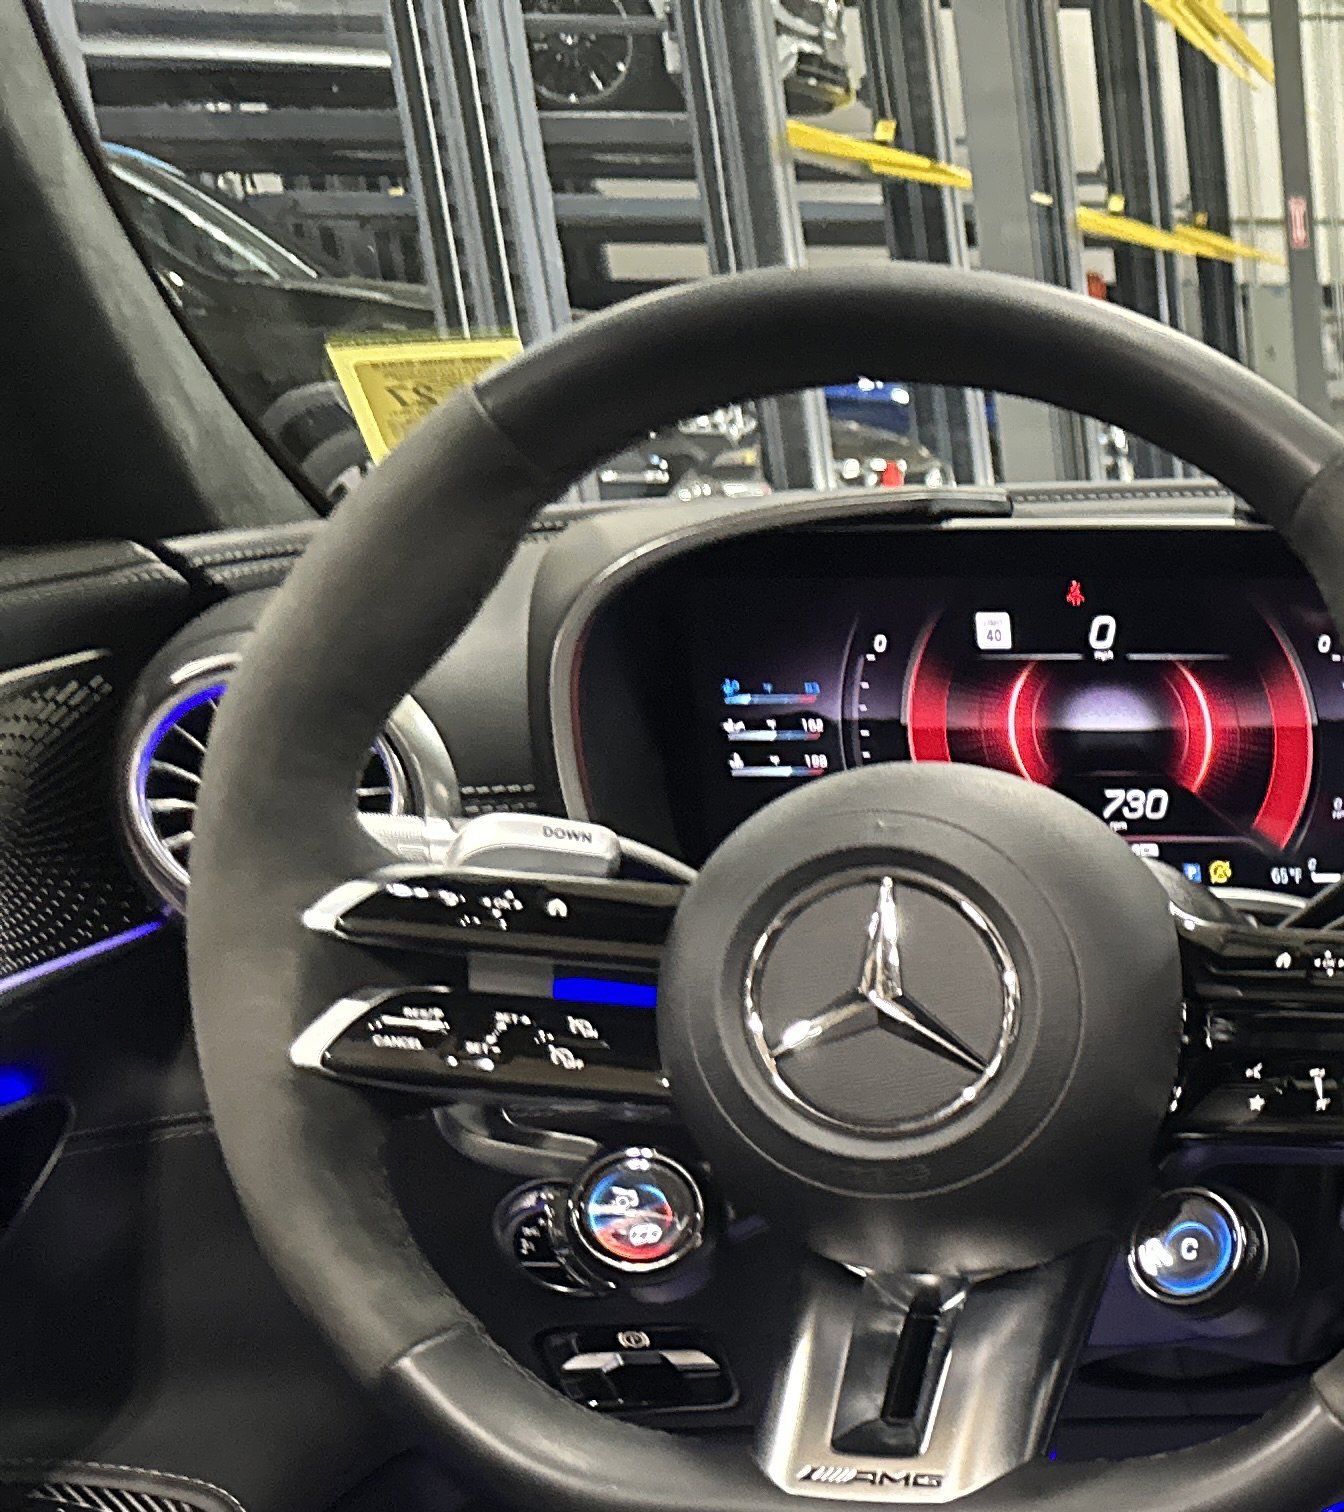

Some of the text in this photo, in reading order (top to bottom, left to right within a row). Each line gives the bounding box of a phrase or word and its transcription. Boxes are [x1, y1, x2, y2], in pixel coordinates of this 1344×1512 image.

[986, 629, 1002, 642] 40
[1088, 614, 1117, 650] 0
[873, 634, 888, 653] 0
[1317, 634, 1332, 654] 0
[543, 825, 593, 844] DOWN
[1180, 1237, 1199, 1261] C
